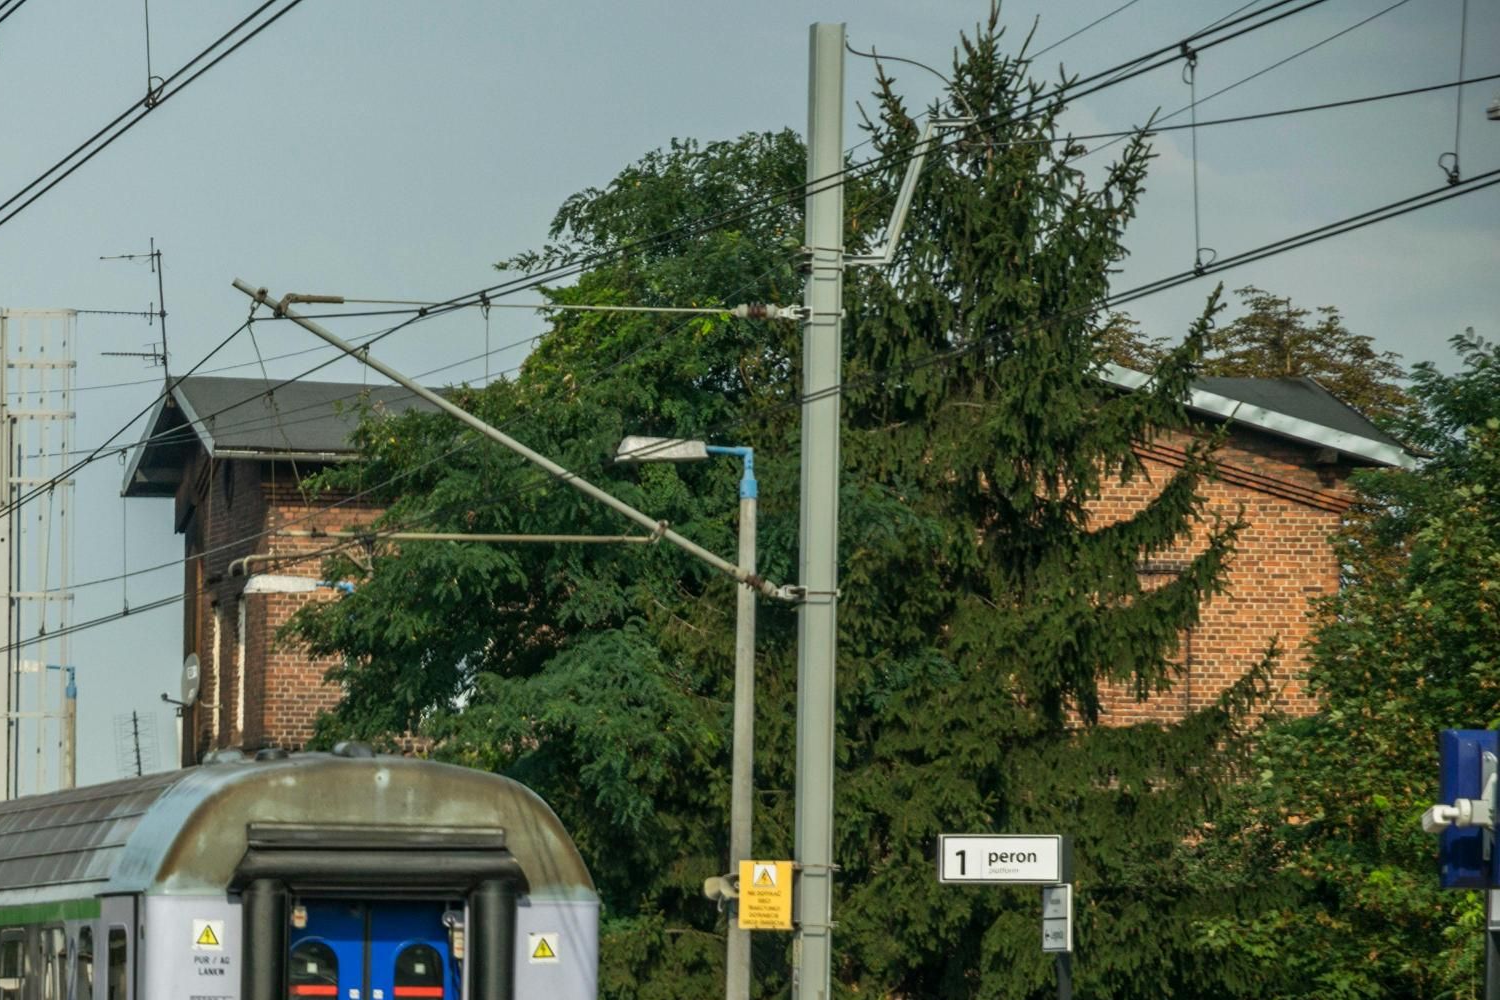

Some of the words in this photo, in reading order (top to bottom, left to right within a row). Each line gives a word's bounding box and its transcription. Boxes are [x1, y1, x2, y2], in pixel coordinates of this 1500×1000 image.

[955, 849, 967, 876] 1
[987, 851, 1038, 867] peron
[193, 955, 210, 965] PUR
